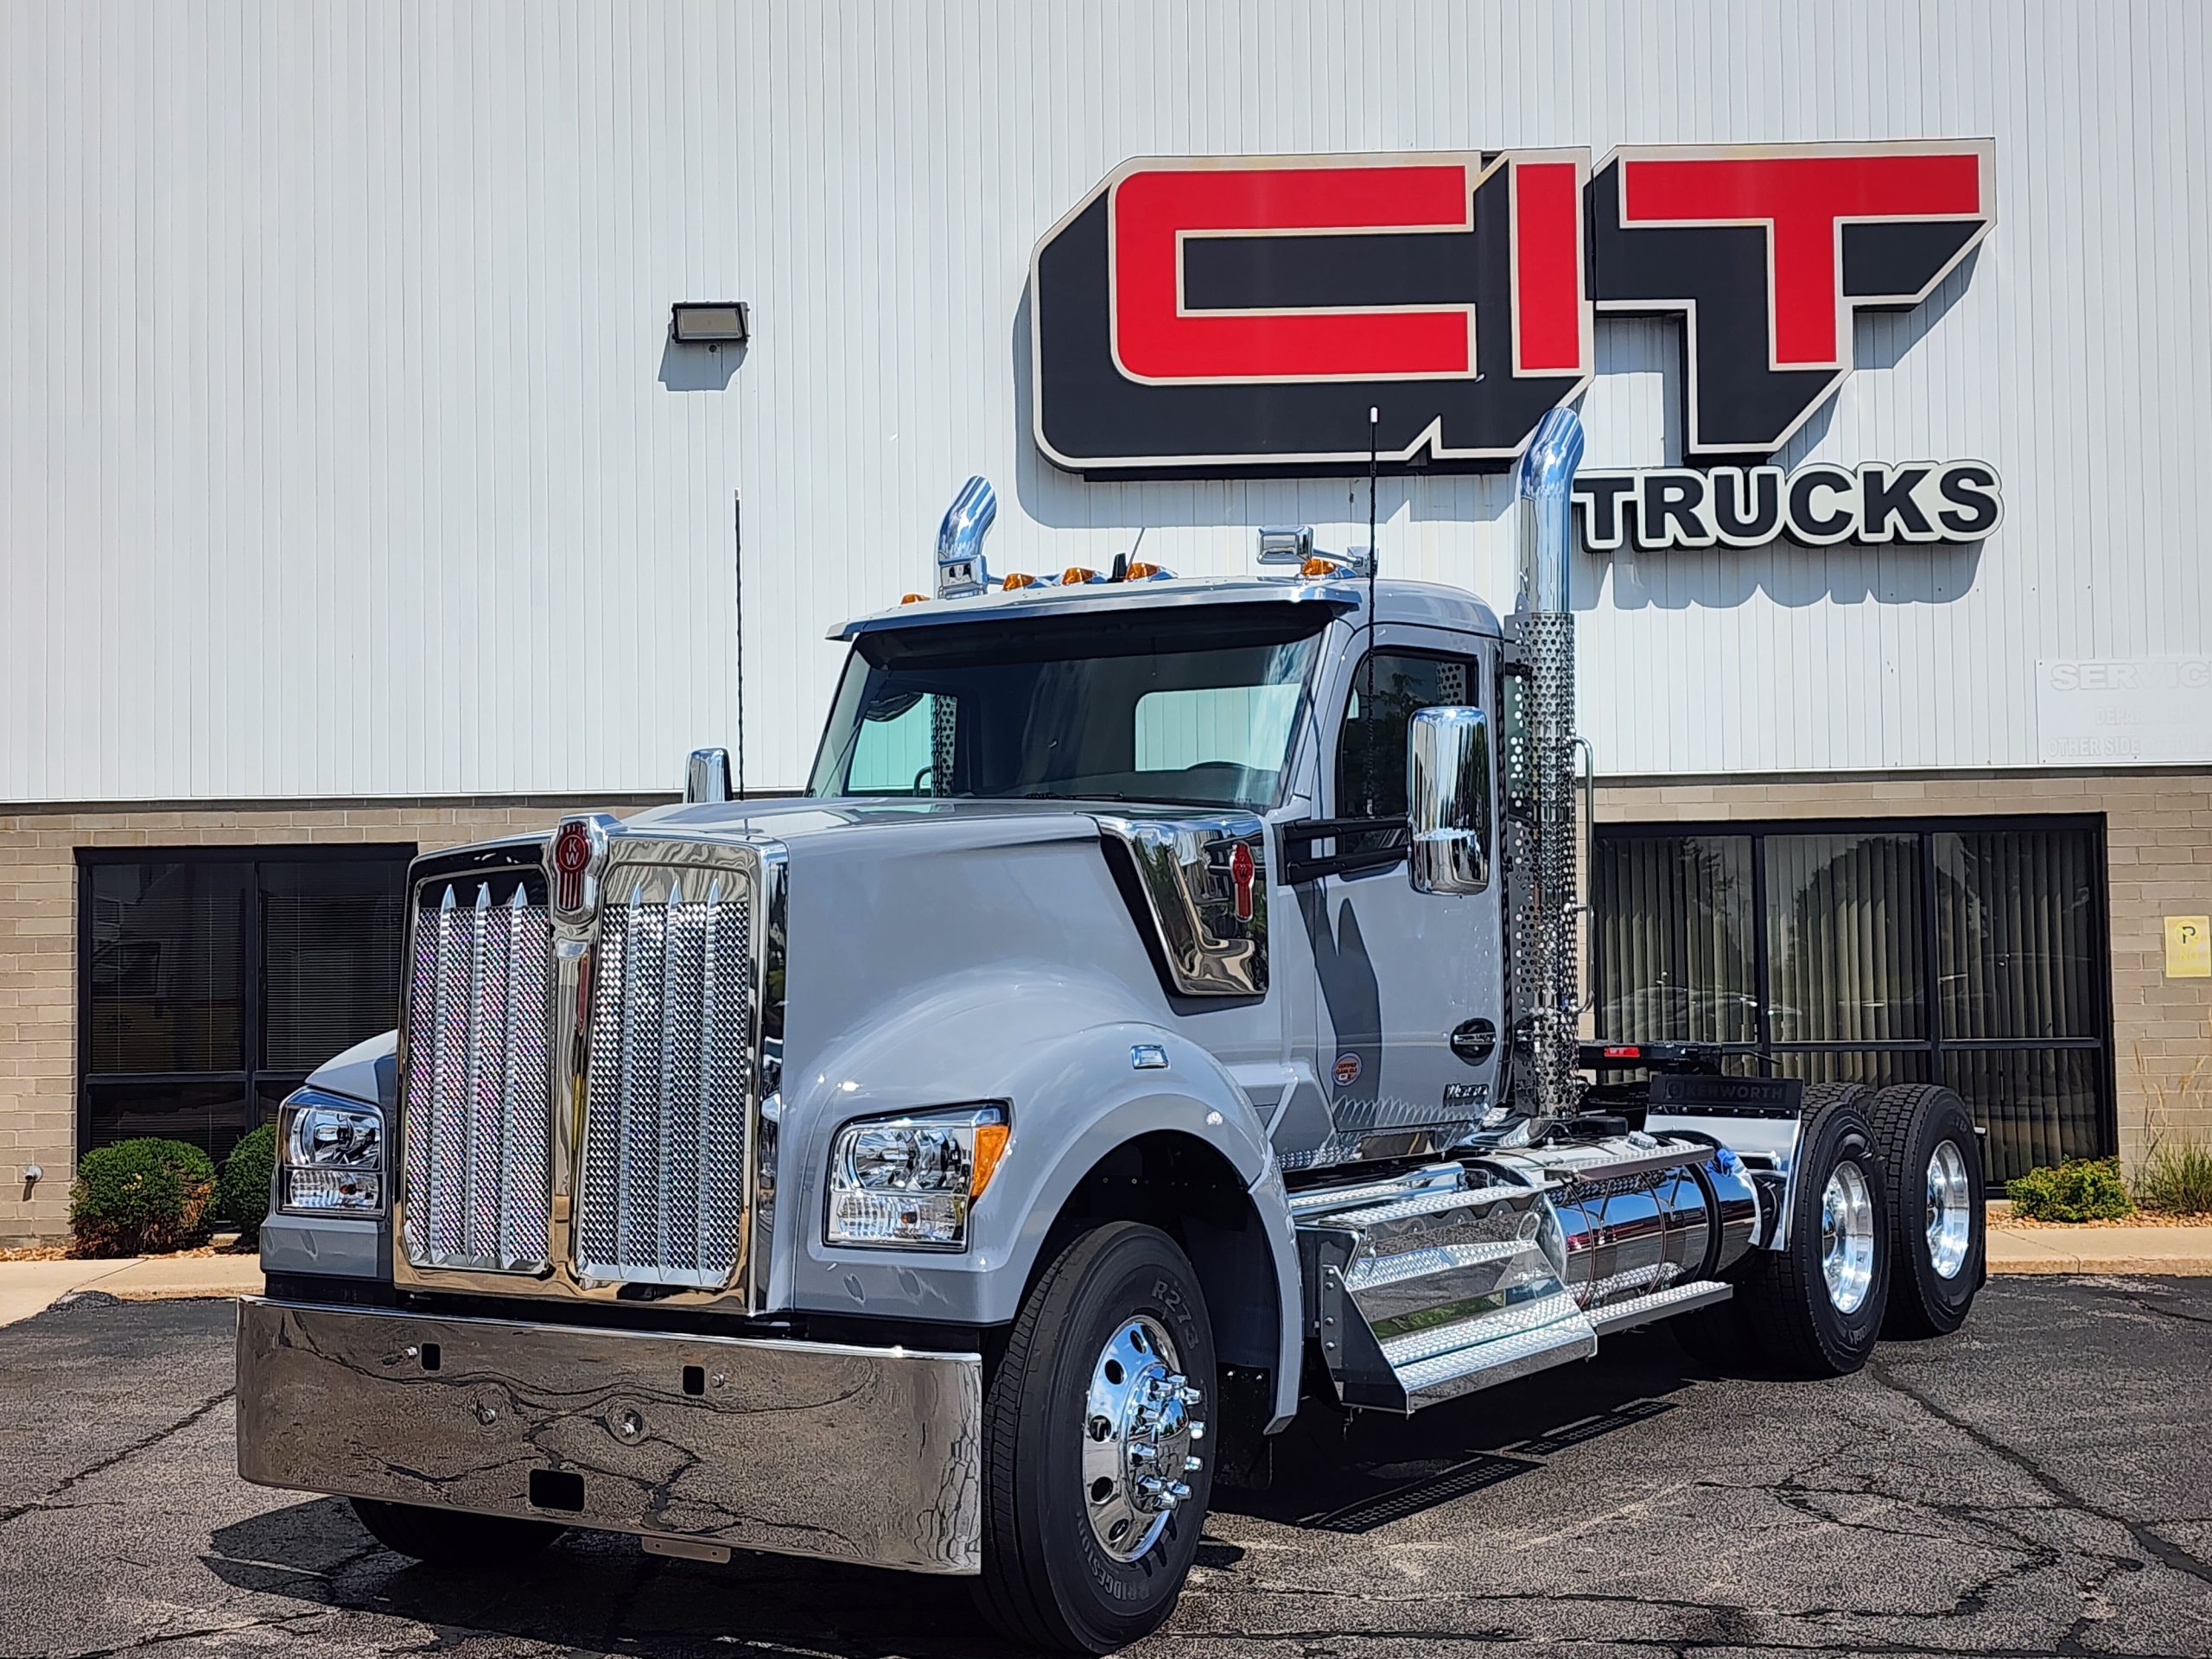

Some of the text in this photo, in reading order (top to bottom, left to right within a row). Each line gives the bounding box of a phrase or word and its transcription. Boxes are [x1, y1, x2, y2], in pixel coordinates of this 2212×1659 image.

[1109, 143, 1994, 382] CIT
[1573, 466, 1999, 543] TRUCKS
[2050, 661, 2212, 690] SERVIC
[2046, 736, 2101, 757] OTHER
[2103, 734, 2141, 756] SIDE
[1687, 1084, 1783, 1100] KENWORTH
